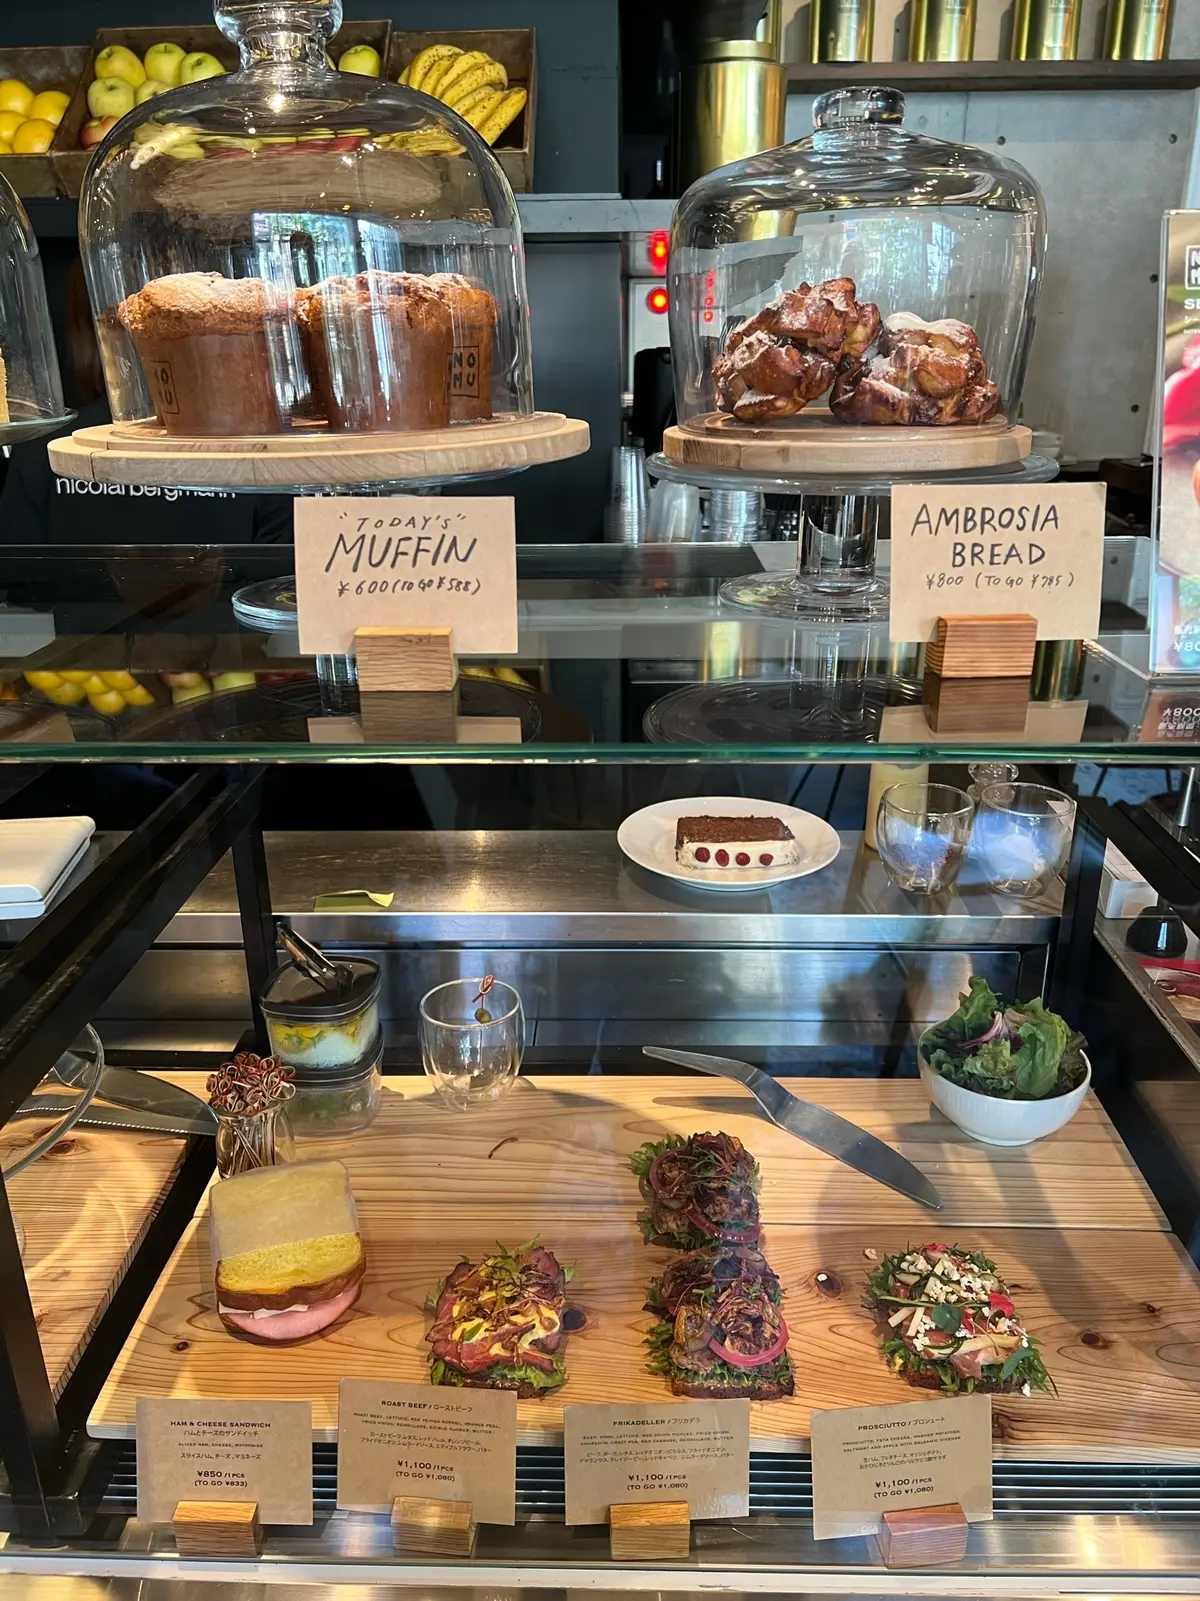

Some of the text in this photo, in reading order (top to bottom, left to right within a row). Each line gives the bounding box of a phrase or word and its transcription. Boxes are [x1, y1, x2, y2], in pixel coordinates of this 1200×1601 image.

[454, 352, 476, 369] NO
[911, 503, 1059, 537] AMBROSIA
[325, 533, 478, 573] MUFFIN
[951, 542, 1046, 568] BREAD
[926, 573, 963, 590] ¥800
[1005, 576, 1023, 588] GO
[434, 1404, 473, 1413] ローストビーフ
[672, 1417, 701, 1425] フリカデラ
[858, 1421, 907, 1431] PROSCIUTTO
[912, 1416, 945, 1426] プロシュート
[397, 1460, 432, 1470] ¥1,100
[197, 1470, 223, 1478] ¥850
[426, 1474, 456, 1482] ¥1,080)
[628, 1474, 664, 1482] ¥1,100
[875, 1478, 910, 1489] ¥1,100
[874, 1491, 888, 1499] (TO
[904, 1486, 934, 1495] ¥1,080)
